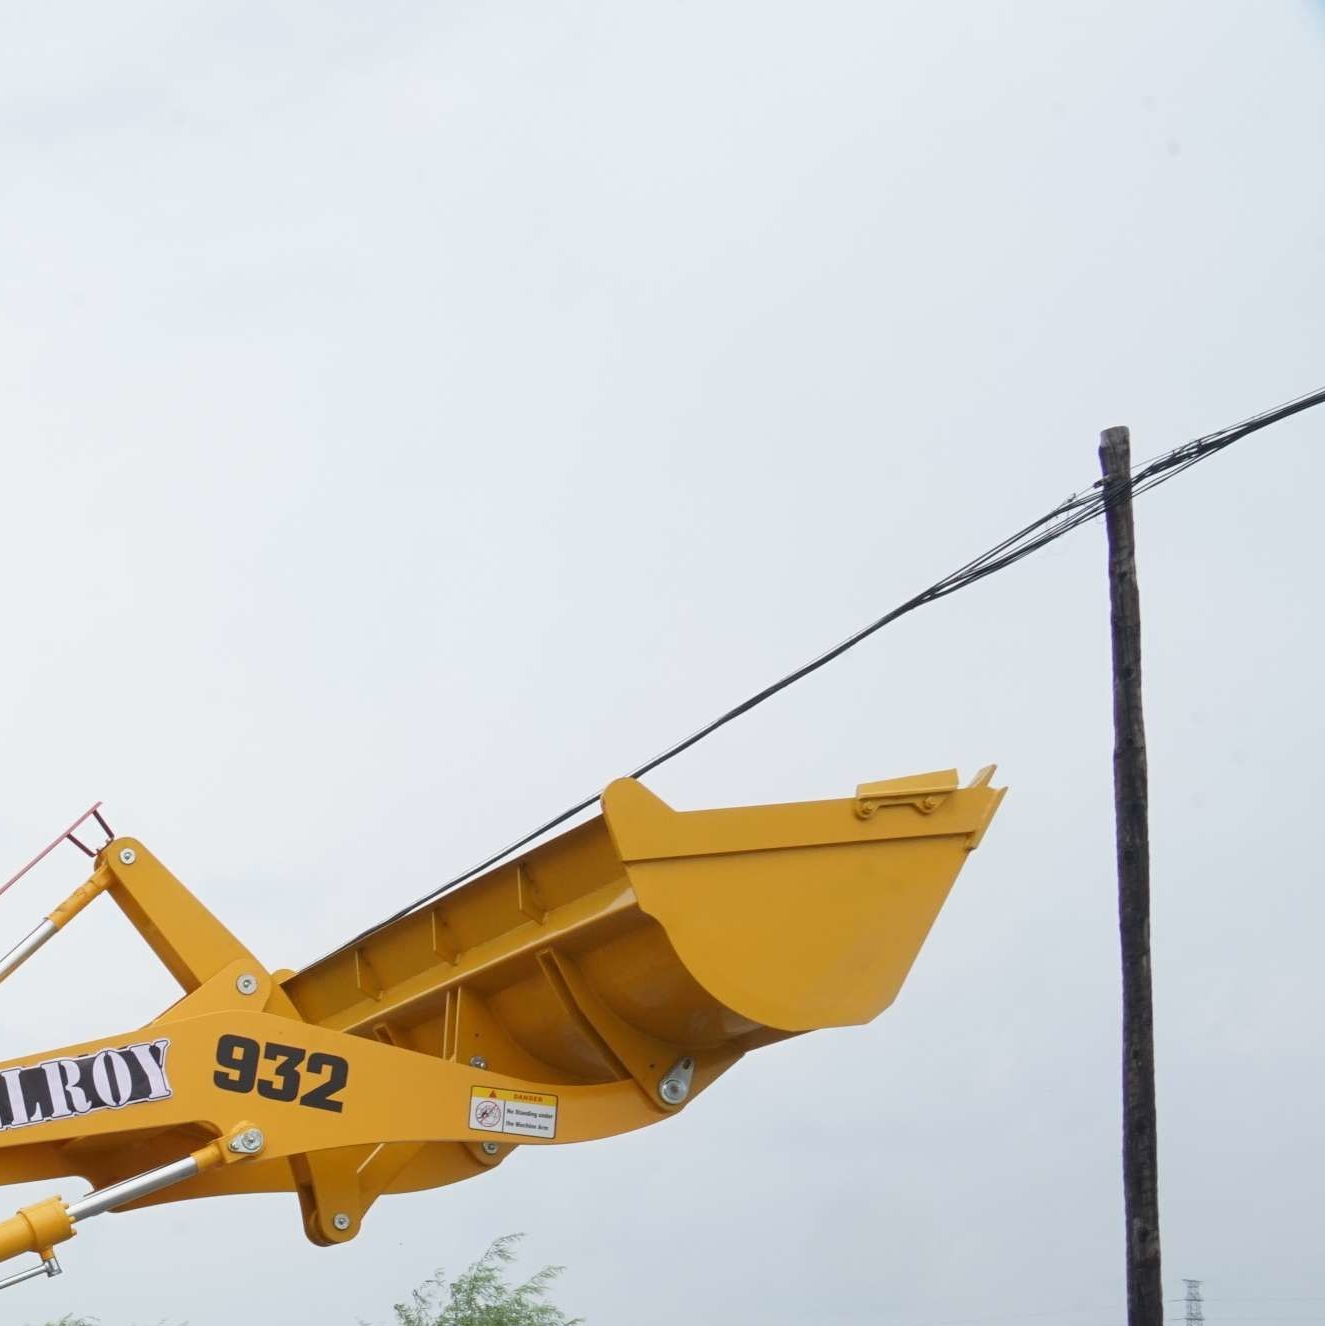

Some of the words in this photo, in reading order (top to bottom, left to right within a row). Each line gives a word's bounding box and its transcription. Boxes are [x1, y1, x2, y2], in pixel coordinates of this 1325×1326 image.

[213, 1033, 349, 1113] 932
[513, 1093, 543, 1102] DANGER
[515, 1109, 537, 1118] Standing
[515, 1121, 537, 1129] Machine
